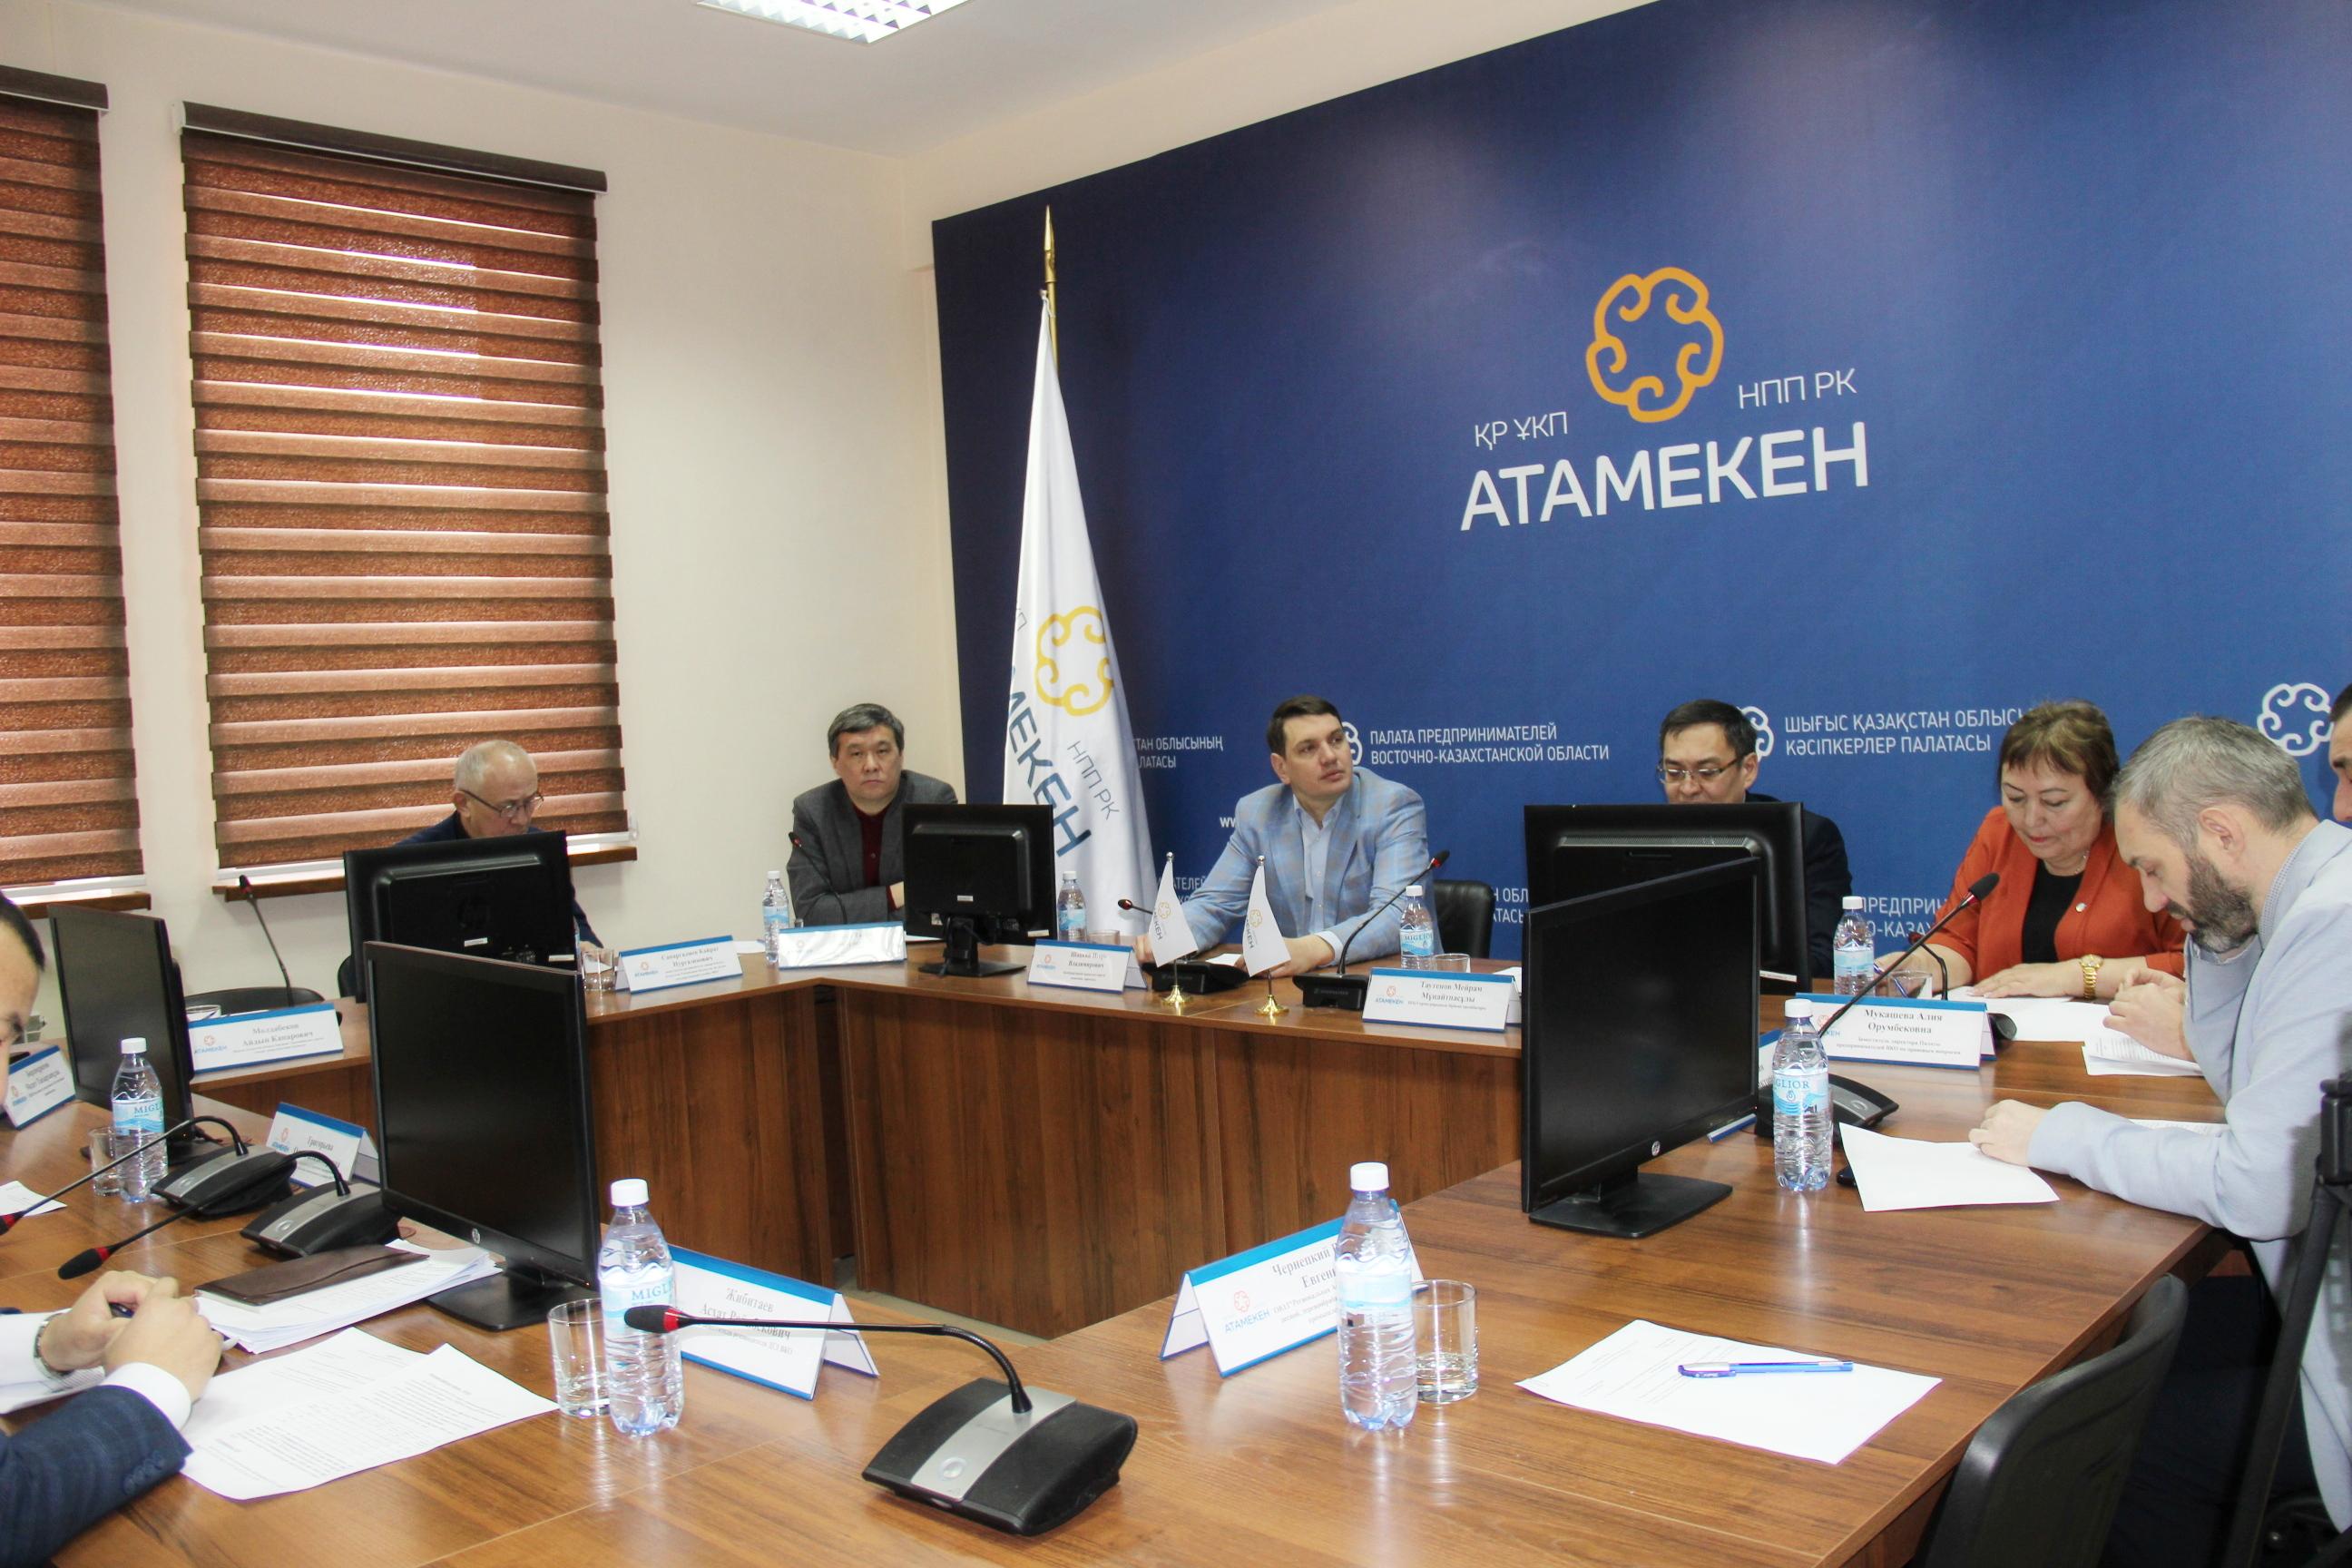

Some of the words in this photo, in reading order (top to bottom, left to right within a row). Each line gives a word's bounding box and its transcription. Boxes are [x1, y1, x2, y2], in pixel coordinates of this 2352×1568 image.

[1738, 375, 1806, 410] НПП
[1815, 367, 1858, 400] РК
[1460, 420, 1869, 532] АТАМЕКЕН
[1370, 729, 1416, 746] ПАЛАТА
[1417, 721, 1558, 747] ПРЕДПРИНИМАТЕЛЕЙ
[1901, 733, 1991, 753] ПАЛАТАСЫ
[1370, 744, 1544, 765] ВОСТОЧНО-КАЗАХСТАНСКОЙ
[1546, 744, 1610, 762] ОБЛАСТИ
[1066, 740, 1103, 790] НПП
[1093, 787, 1121, 821] РК
[1918, 1011, 1944, 1022] Алия
[1224, 1308, 1270, 1334] АТАМЕКЕН
